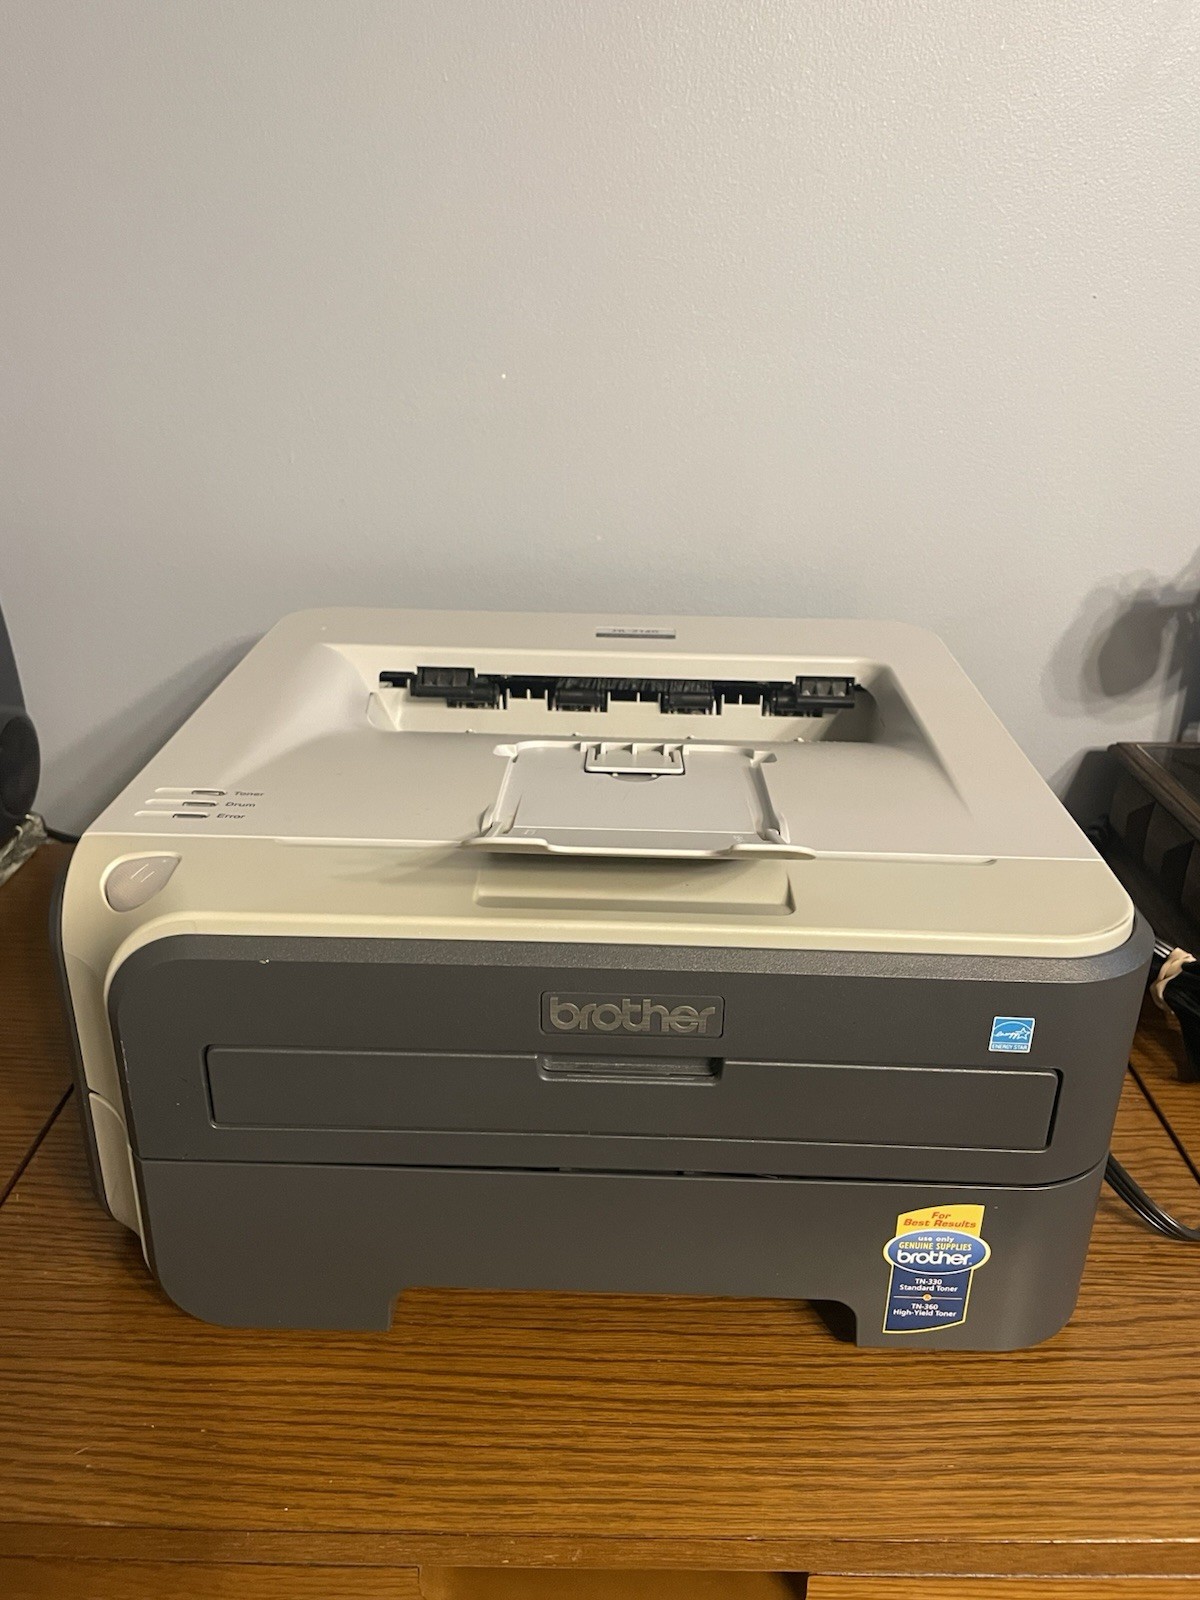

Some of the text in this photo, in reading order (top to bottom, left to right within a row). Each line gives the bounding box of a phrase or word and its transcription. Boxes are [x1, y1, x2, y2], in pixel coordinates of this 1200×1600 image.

[550, 996, 716, 1034] brother
[931, 1211, 951, 1219] For
[903, 1218, 976, 1228] Best Results
[899, 1242, 972, 1251] GENUINE SUPPLIES
[897, 1250, 972, 1265] brother
[893, 1309, 933, 1317] High-Yield
